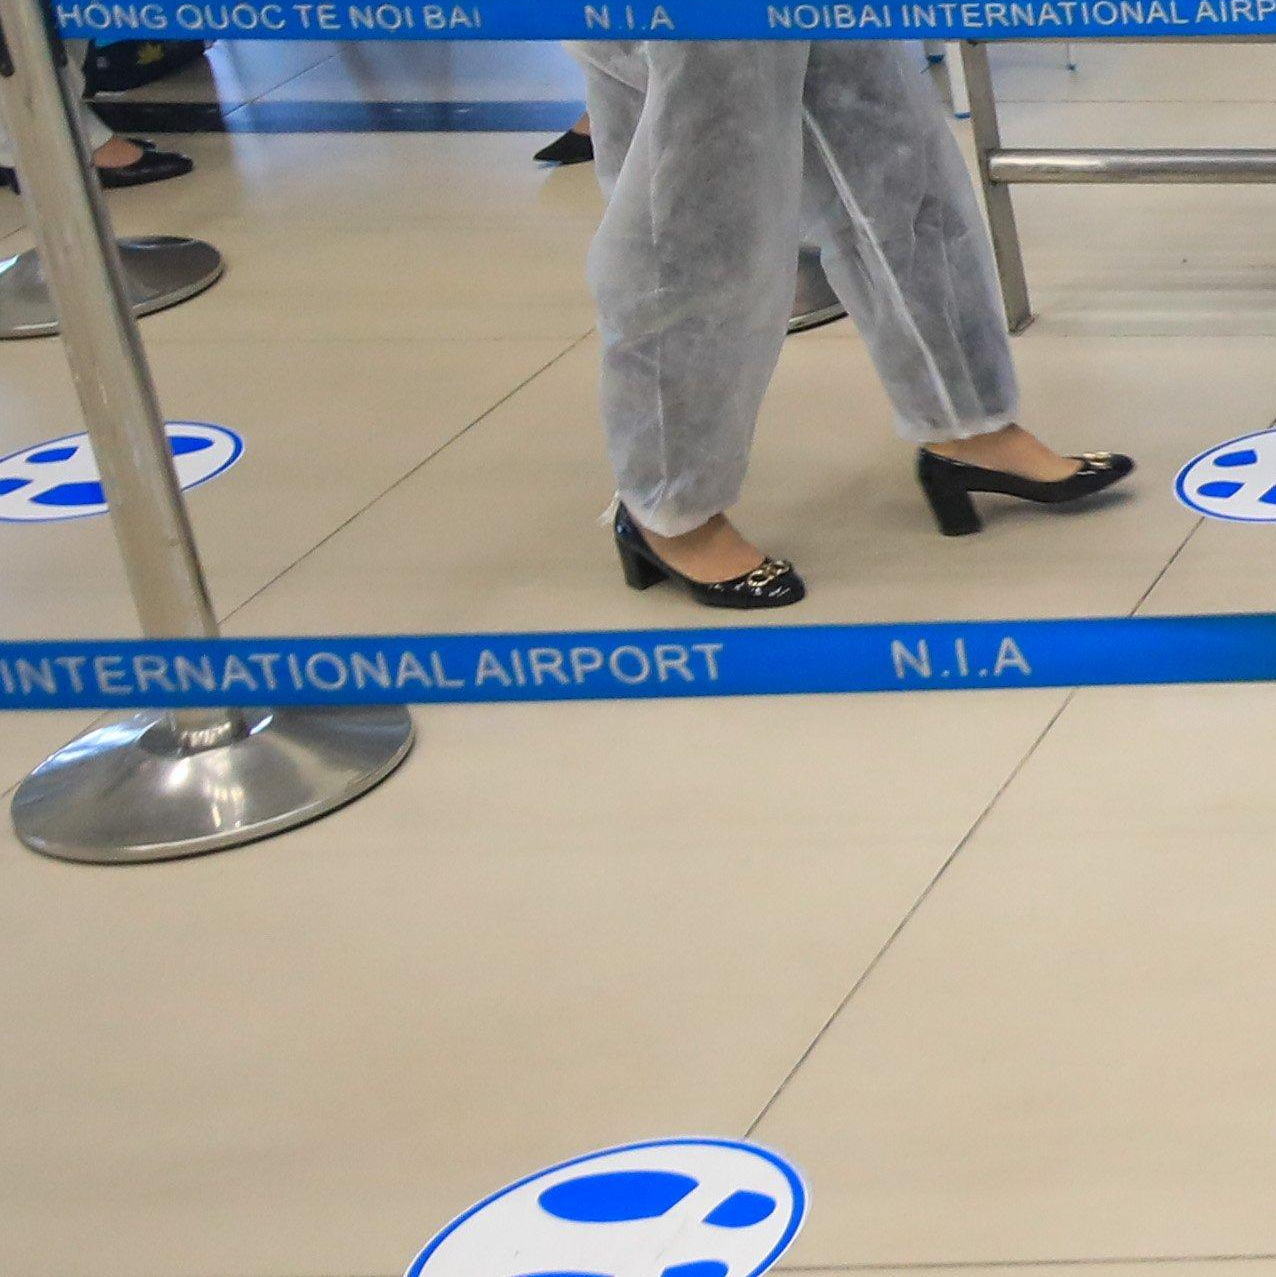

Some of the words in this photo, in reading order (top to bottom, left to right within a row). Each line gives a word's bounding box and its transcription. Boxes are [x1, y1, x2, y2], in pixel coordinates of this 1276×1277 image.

[584, 3, 675, 32] N.I.A
[767, 3, 893, 32] NOIBAI
[1, 646, 465, 695] INTERNATIONAL
[473, 641, 724, 686] AIRPORT
[890, 636, 1032, 680] N.I.A
